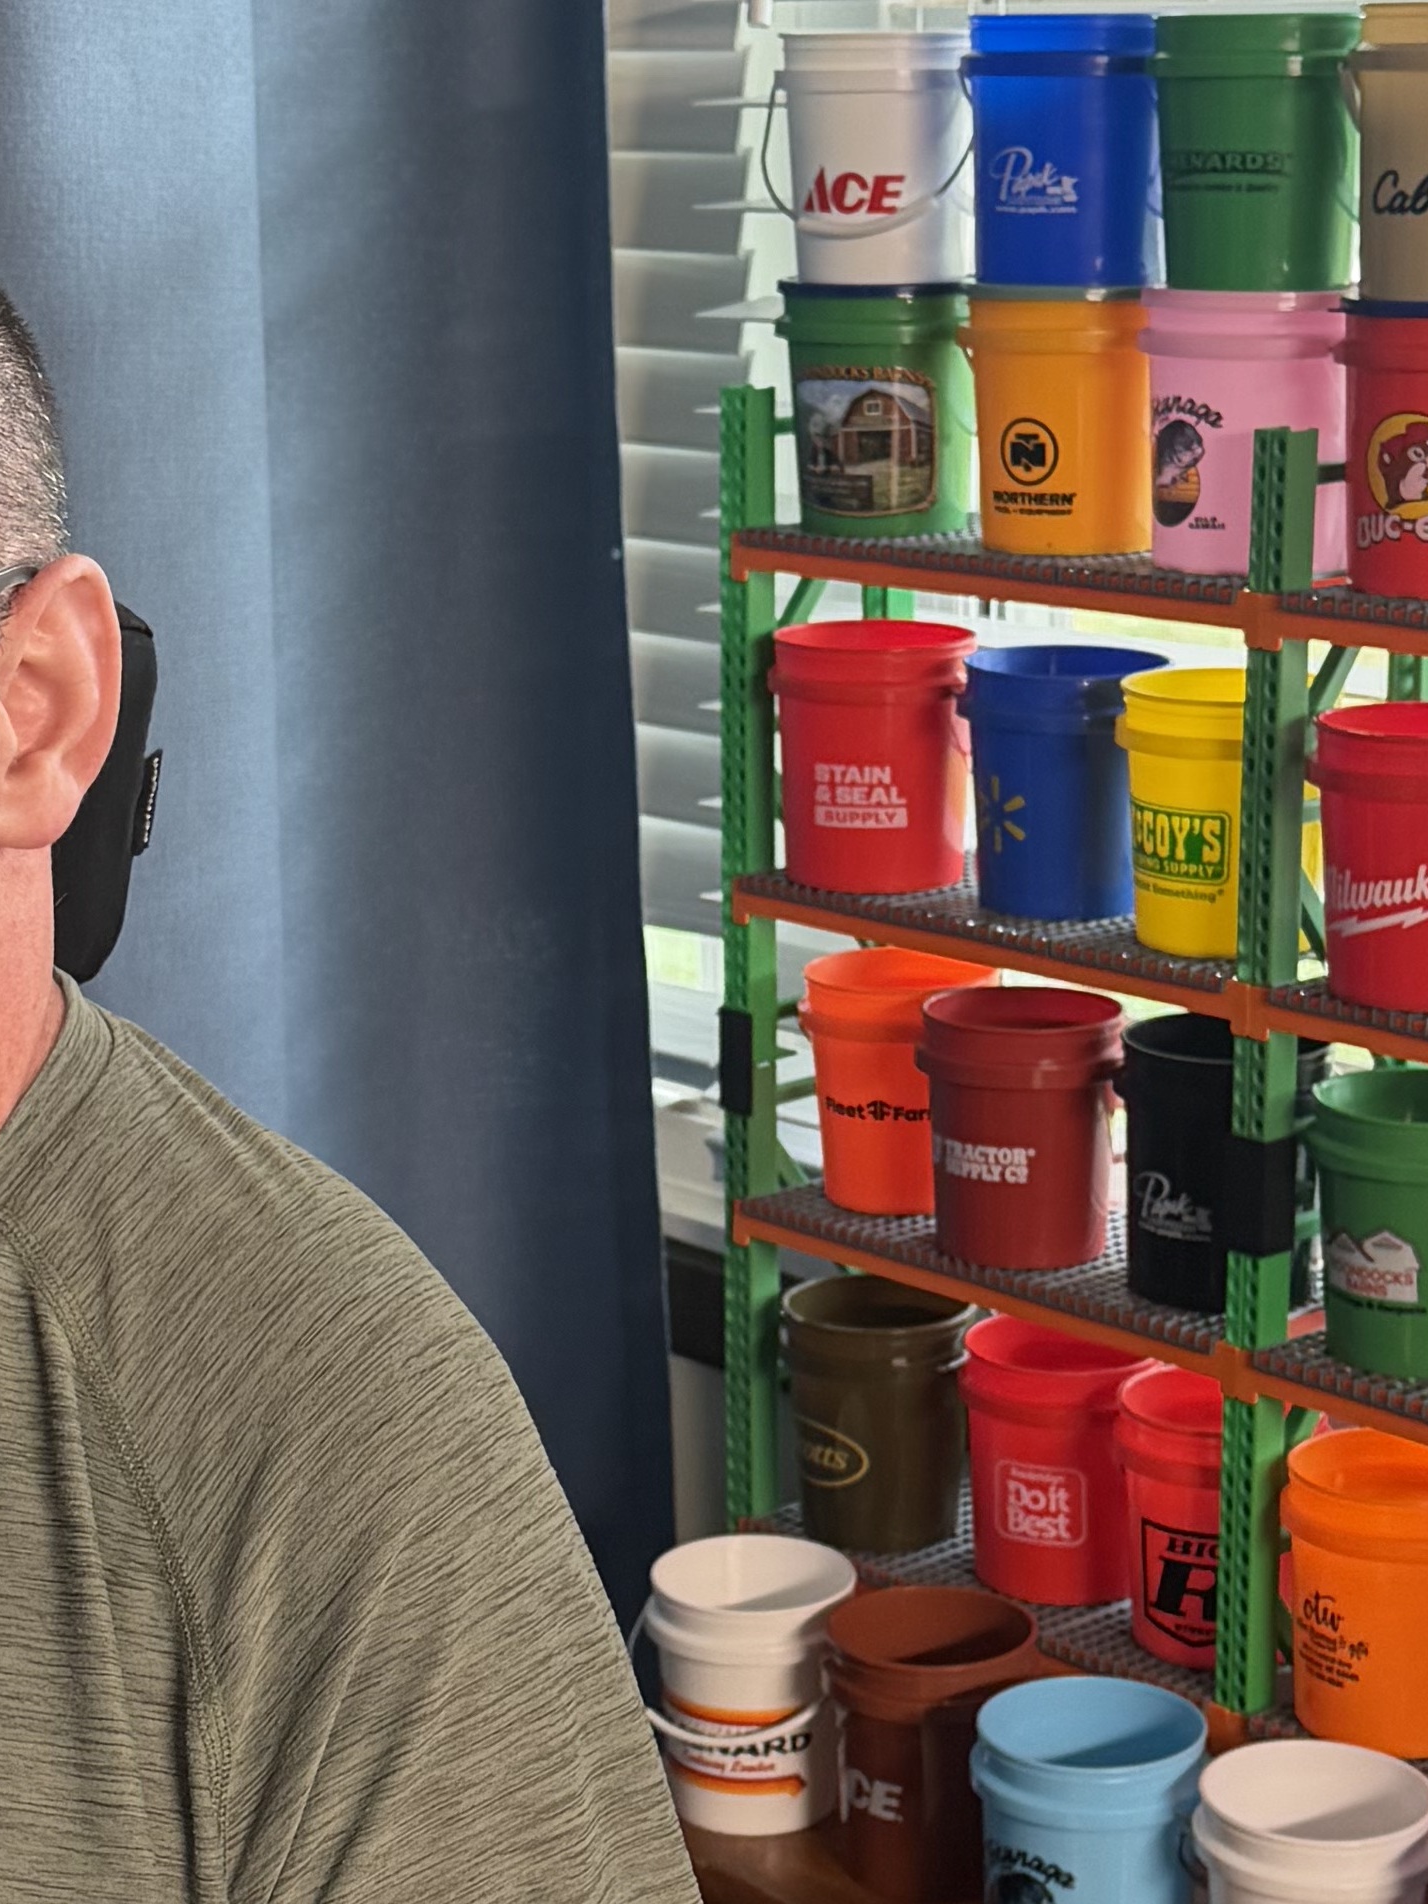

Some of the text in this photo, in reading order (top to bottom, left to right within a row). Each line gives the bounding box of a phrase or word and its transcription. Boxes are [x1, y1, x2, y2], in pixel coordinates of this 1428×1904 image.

[803, 165, 905, 215] ACE
[814, 762, 891, 786] STAIN
[835, 785, 908, 807] SEAL
[945, 1138, 1028, 1166] TRACTOR
[1006, 1503, 1073, 1539] Best
